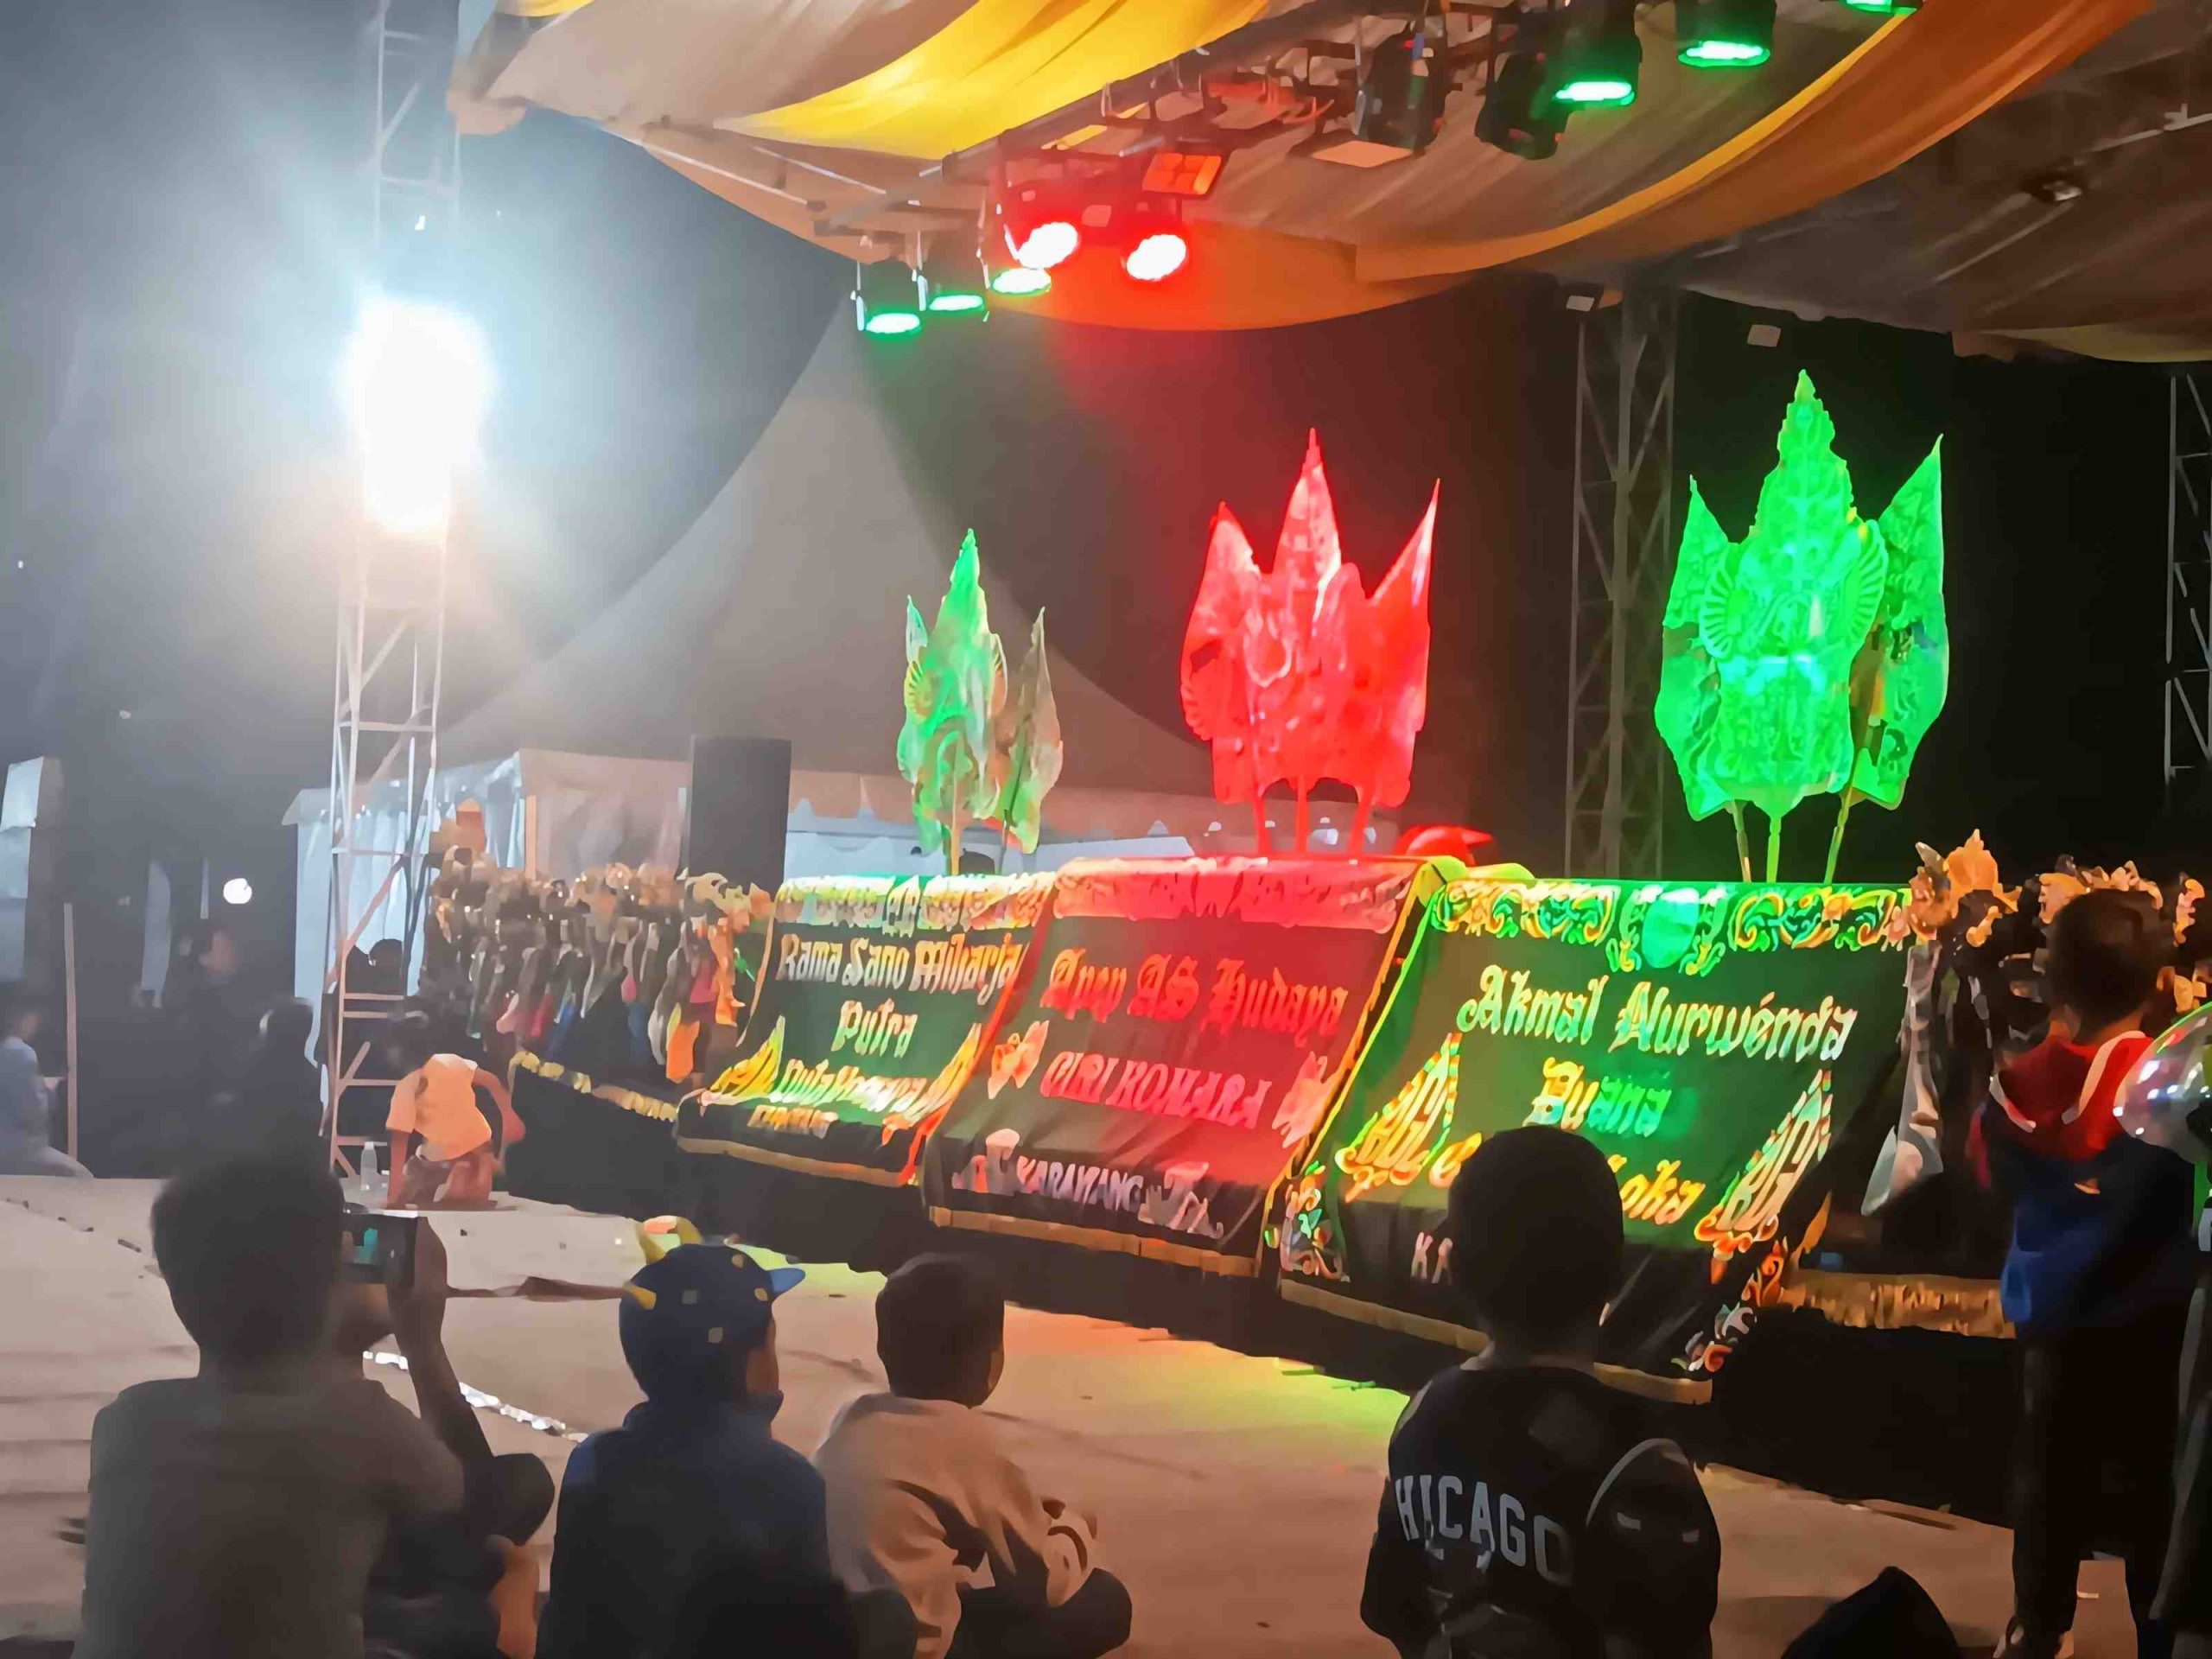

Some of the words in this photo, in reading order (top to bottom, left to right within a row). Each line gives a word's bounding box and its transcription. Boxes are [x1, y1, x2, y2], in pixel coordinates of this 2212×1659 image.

[776, 933, 843, 982] Rama
[842, 937, 910, 990] Sano
[830, 998, 918, 1058] Putra
[1457, 964, 1609, 1046] Akmal
[1608, 982, 1858, 1063] Nurwénda
